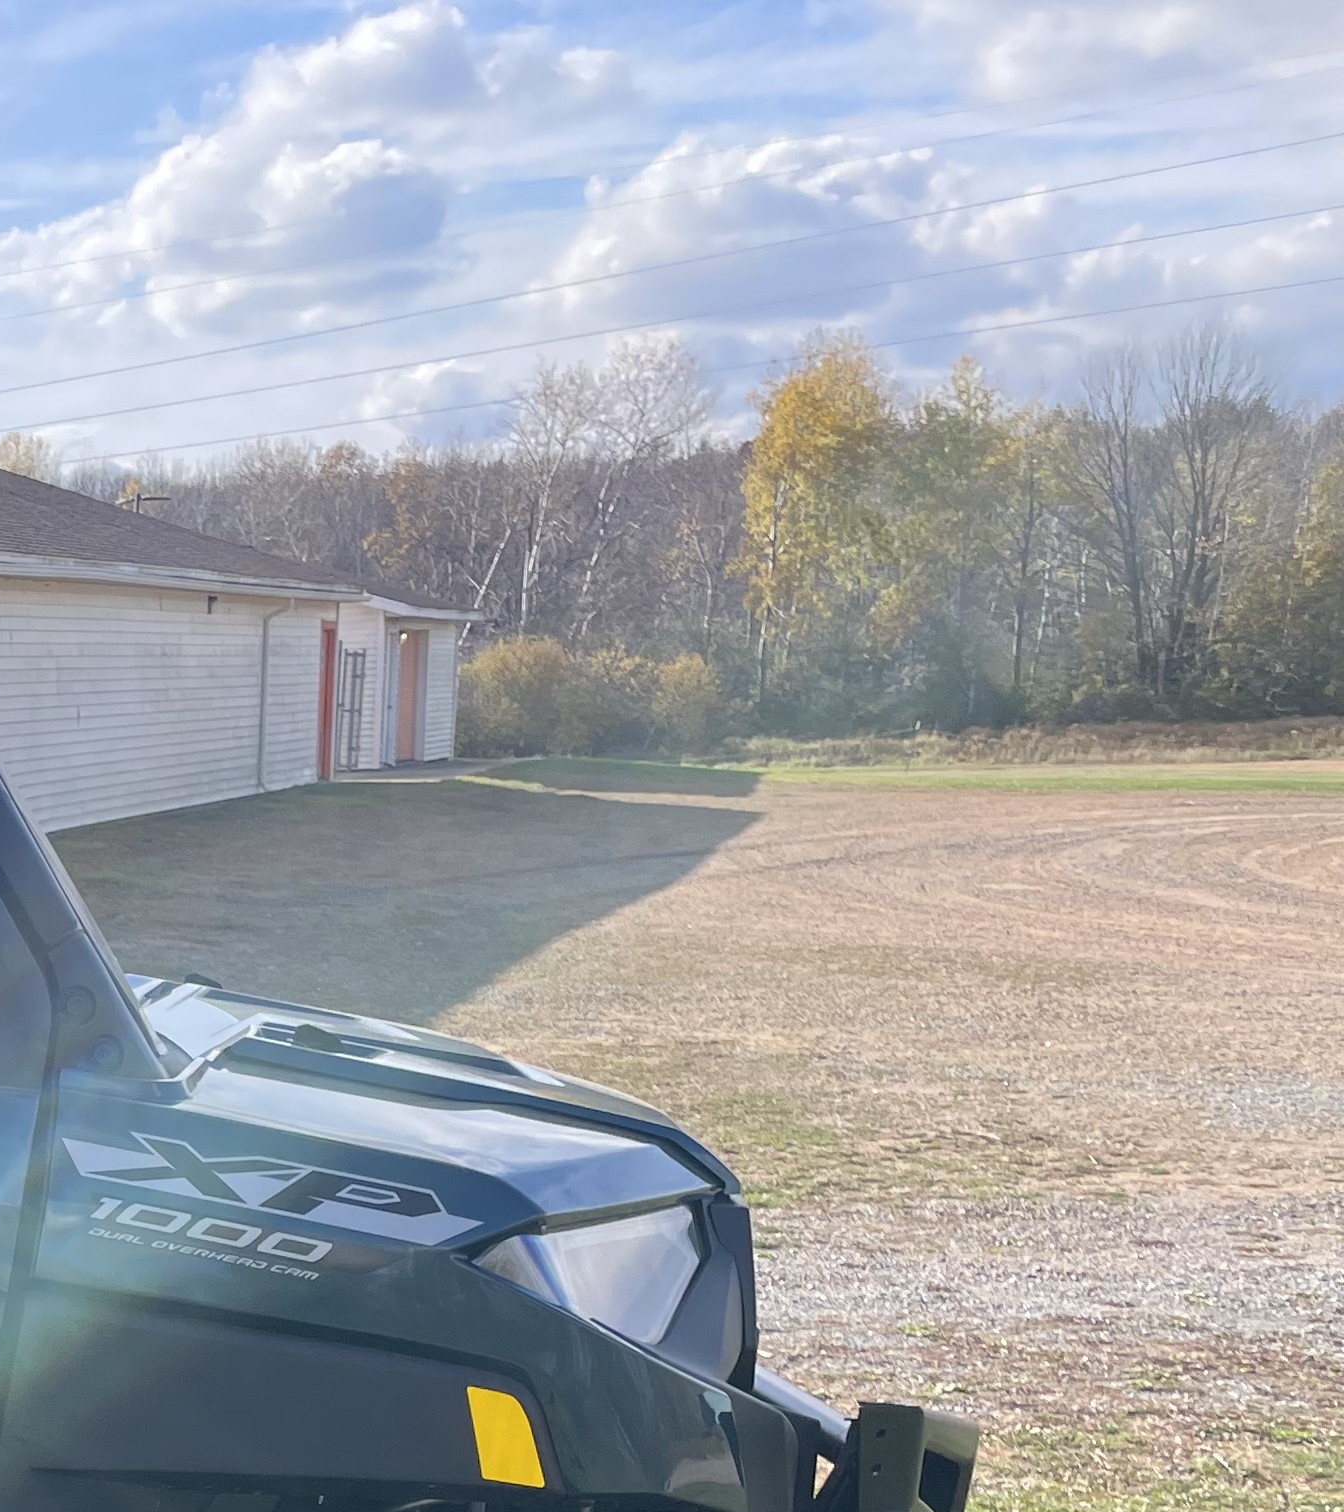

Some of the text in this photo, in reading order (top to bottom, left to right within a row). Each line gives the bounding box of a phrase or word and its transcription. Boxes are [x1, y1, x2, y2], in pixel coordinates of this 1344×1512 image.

[84, 1131, 447, 1217] XP
[87, 1227, 320, 1281] DUAL OVERHEAD CAM
[89, 1197, 333, 1263] 1000
